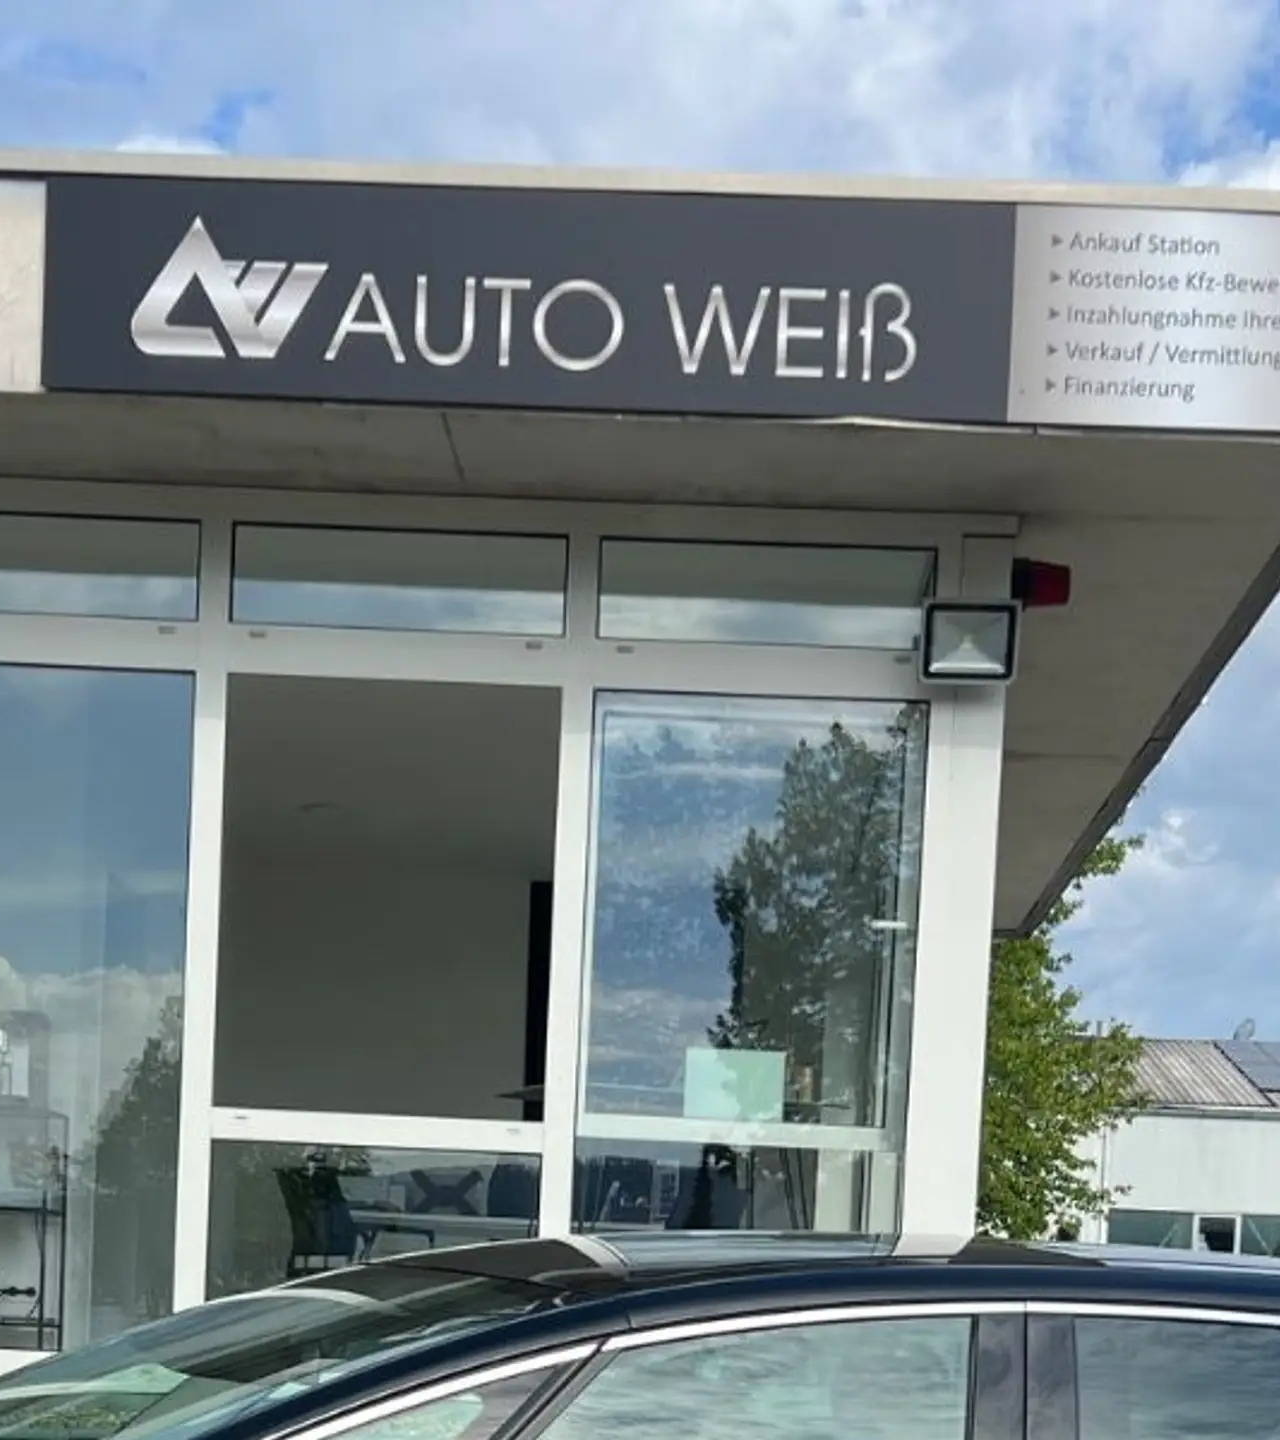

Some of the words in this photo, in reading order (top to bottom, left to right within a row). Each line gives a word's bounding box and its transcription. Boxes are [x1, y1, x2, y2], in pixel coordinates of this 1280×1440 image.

[1070, 231, 1143, 253] Ankauf
[1148, 234, 1220, 256] Station
[1069, 268, 1180, 291] Kostenlose
[324, 273, 625, 371] AUTO
[664, 282, 917, 382] WEIß
[1067, 304, 1237, 331] Inzahlungnahme
[1065, 341, 1144, 363] Verkauf
[1064, 375, 1196, 403] Finanzierung
